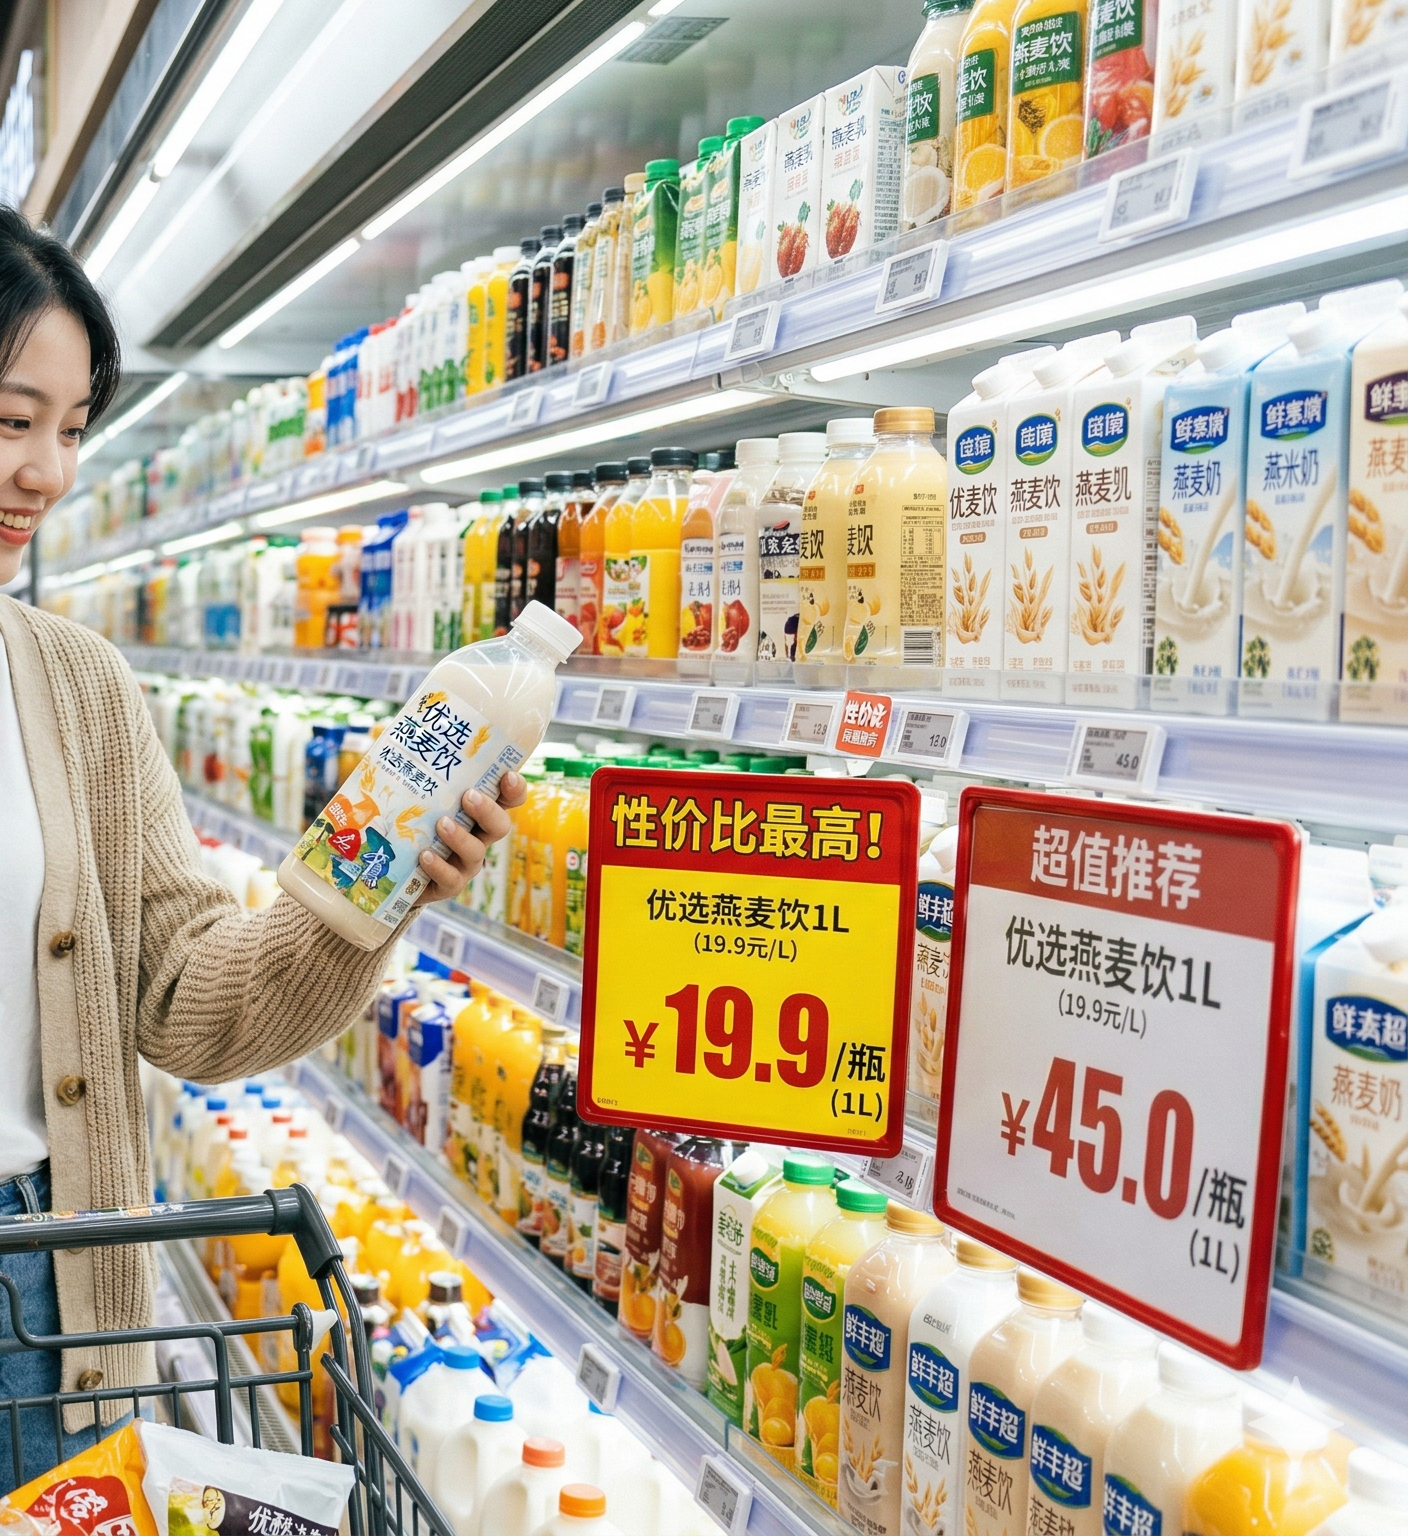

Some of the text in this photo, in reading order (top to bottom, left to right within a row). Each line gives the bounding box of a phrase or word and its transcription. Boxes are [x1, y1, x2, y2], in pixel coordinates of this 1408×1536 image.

[1010, 474, 1061, 513] 燕麦饮
[1172, 460, 1221, 500] 燕麦奶
[422, 701, 472, 750] 优选
[611, 794, 882, 861] 性价比最高!
[1030, 824, 1202, 910] 超值推荐
[646, 888, 850, 933] 优选燕麦饮1L
[693, 932, 798, 962] (19.9元/L)
[1005, 915, 1221, 1009] 优选燕麦饮1L
[1059, 989, 1147, 1039] (19.9元/L)
[831, 1088, 883, 1122] (1L)
[1331, 1063, 1402, 1122] 燕麦奶
[1189, 1229, 1240, 1284] (1L)
